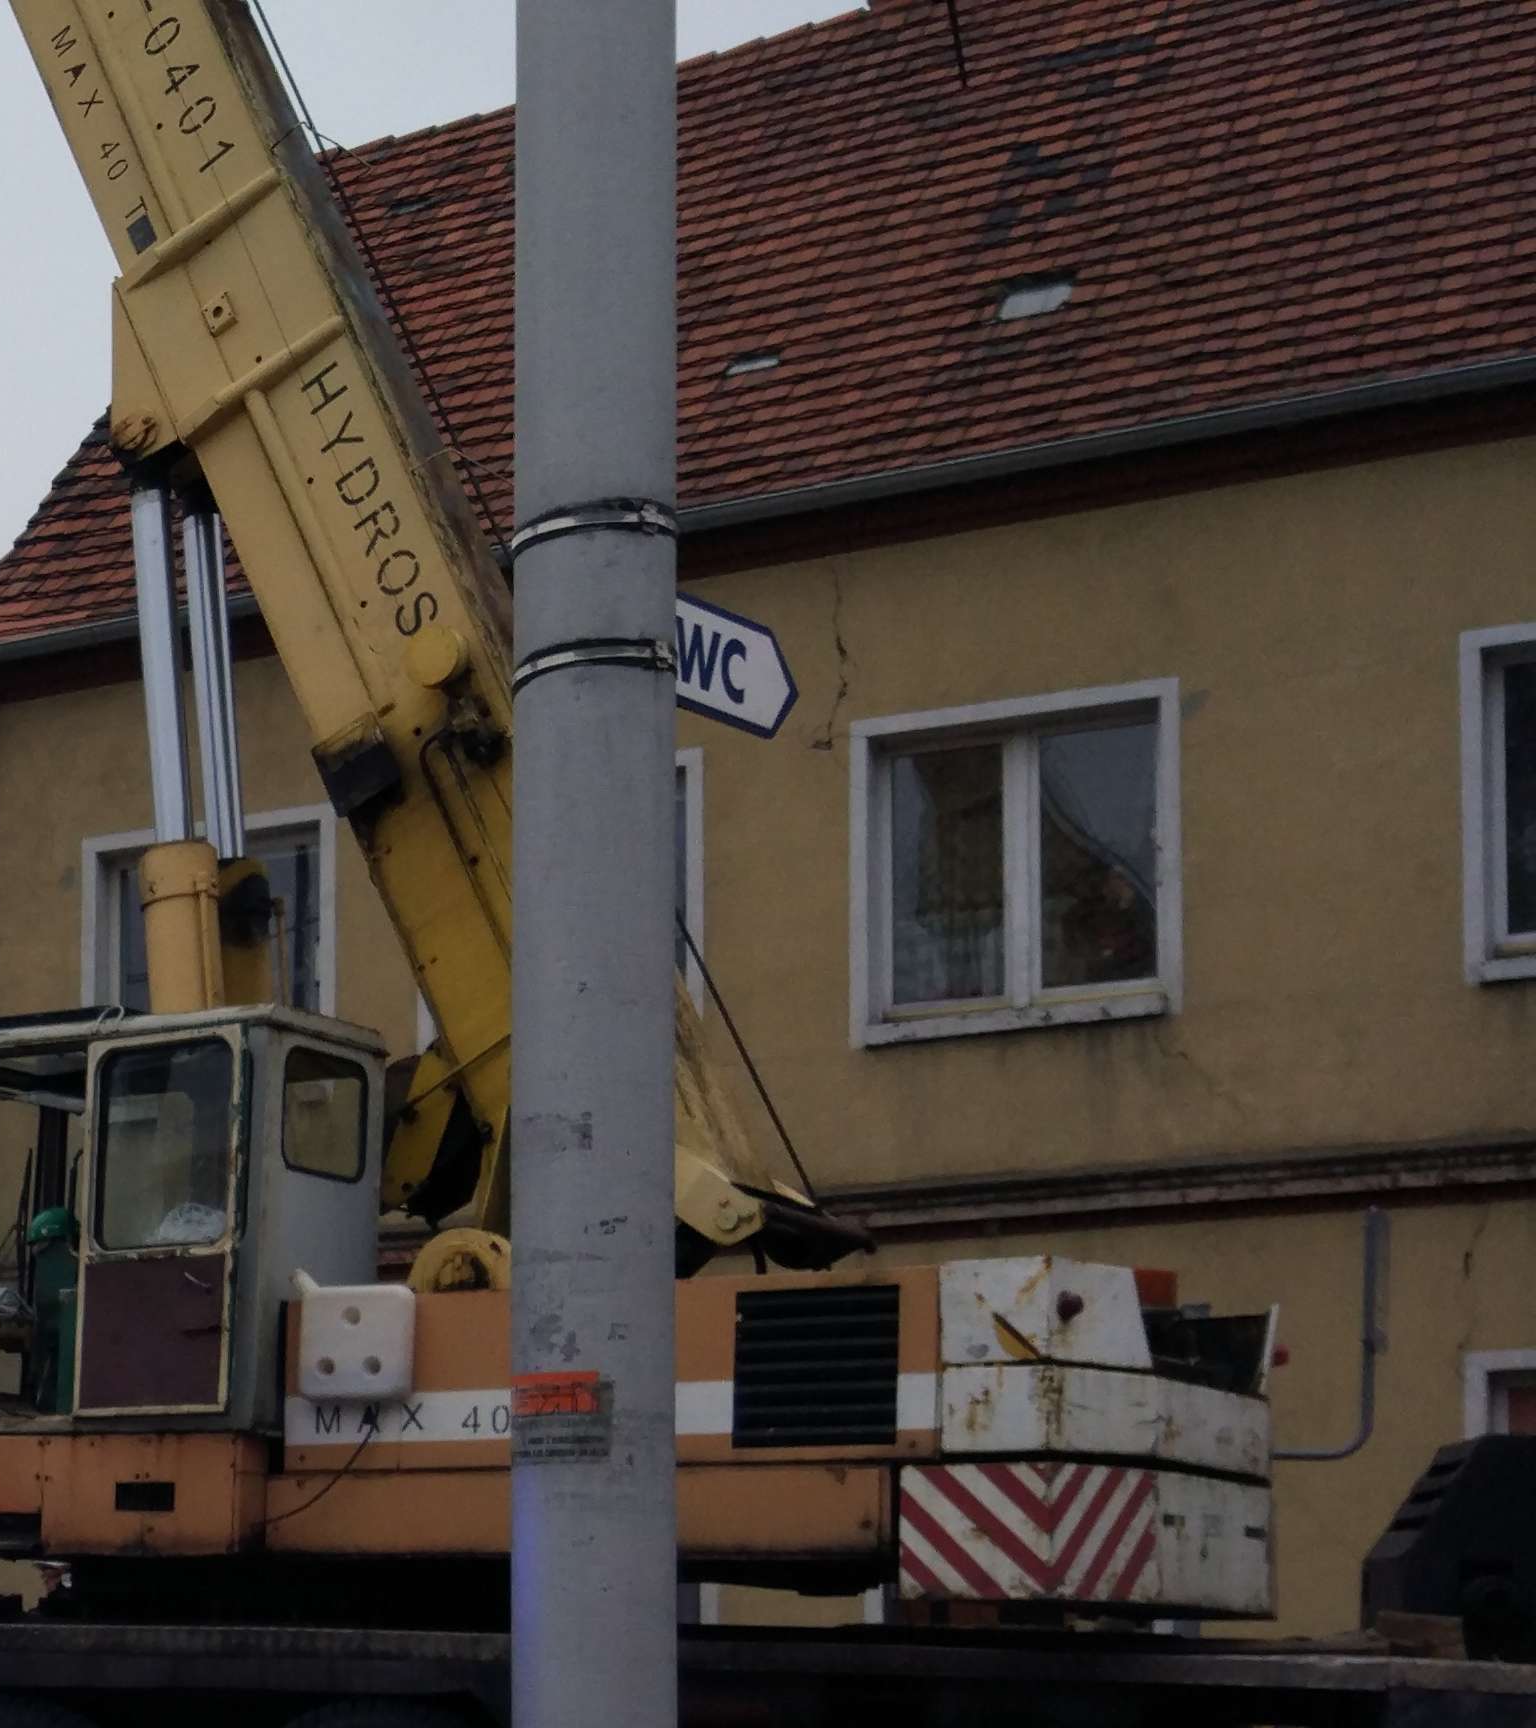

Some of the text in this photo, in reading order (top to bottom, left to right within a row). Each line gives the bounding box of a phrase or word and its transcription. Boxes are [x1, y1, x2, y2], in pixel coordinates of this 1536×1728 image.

[51, 25, 105, 119] MAX
[100, 142, 129, 181] 40
[301, 361, 438, 637] HYDROS
[676, 615, 747, 705] WC
[315, 1402, 424, 1435] MAX
